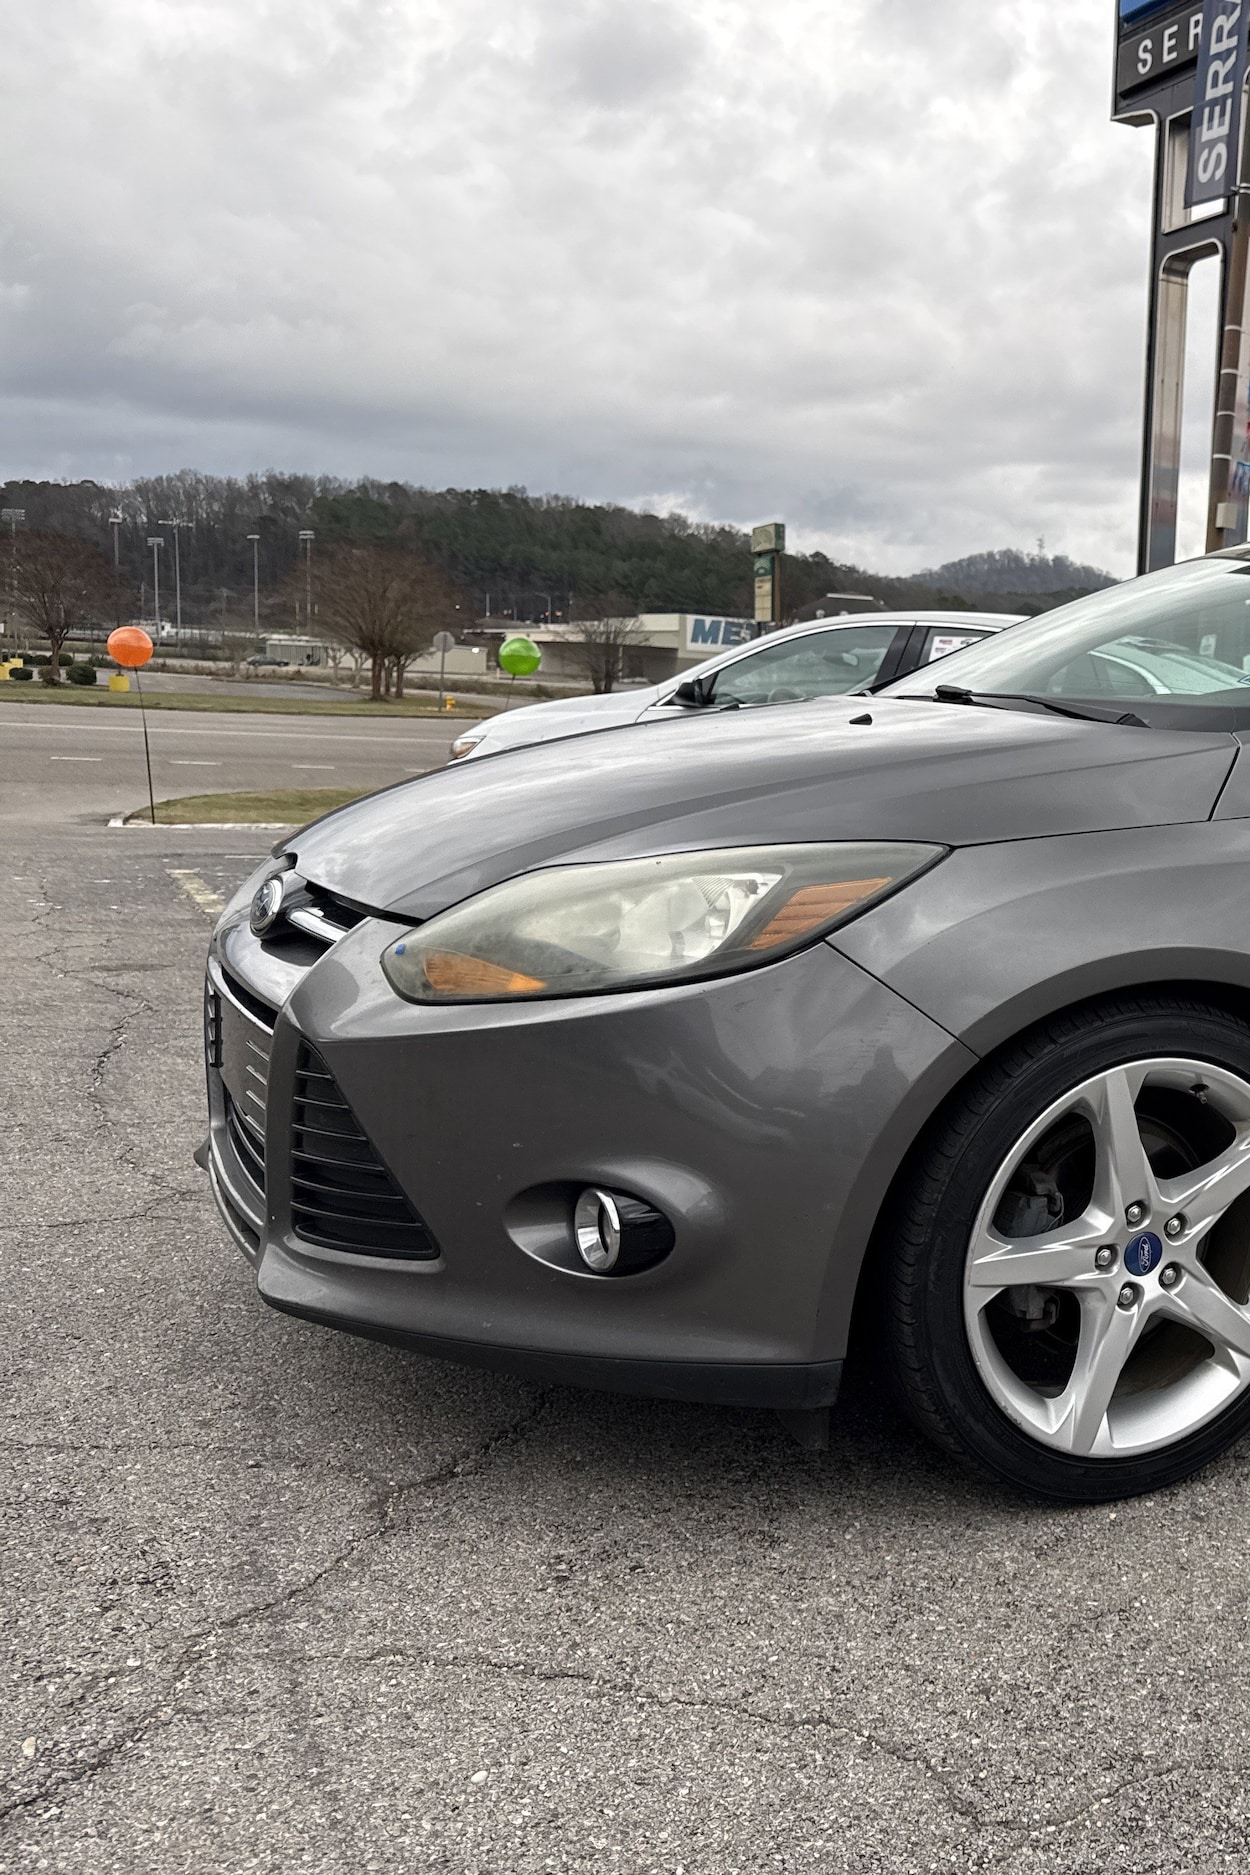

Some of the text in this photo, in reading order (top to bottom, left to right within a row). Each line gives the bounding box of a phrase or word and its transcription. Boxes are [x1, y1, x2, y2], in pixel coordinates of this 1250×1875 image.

[1137, 12, 1203, 74] SER
[1198, 0, 1242, 183] SERR
[1141, 1243, 1149, 1266] Ford
